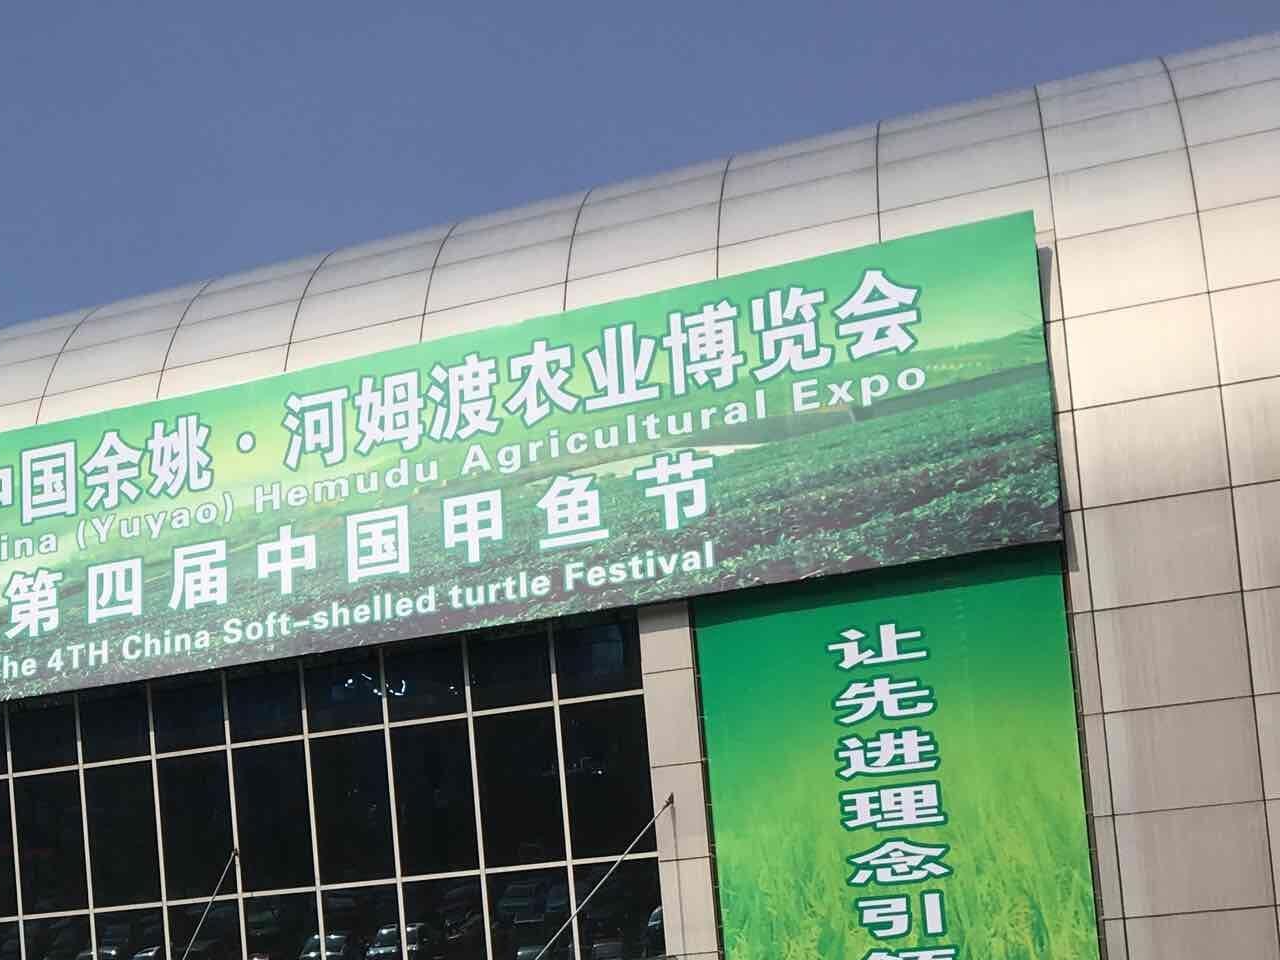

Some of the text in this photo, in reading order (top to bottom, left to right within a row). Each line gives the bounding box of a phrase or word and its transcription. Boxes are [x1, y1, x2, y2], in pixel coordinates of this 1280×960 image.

[75, 492, 234, 549] (Yuyao)
[254, 458, 439, 513] Hemudu
[461, 388, 766, 476] Agricultural
[792, 366, 927, 411] Expo
[47, 639, 109, 671] 4TH
[122, 629, 210, 661] China
[223, 586, 437, 645] Soft-shelled
[449, 572, 551, 609] turtle
[564, 541, 715, 592] Festival
